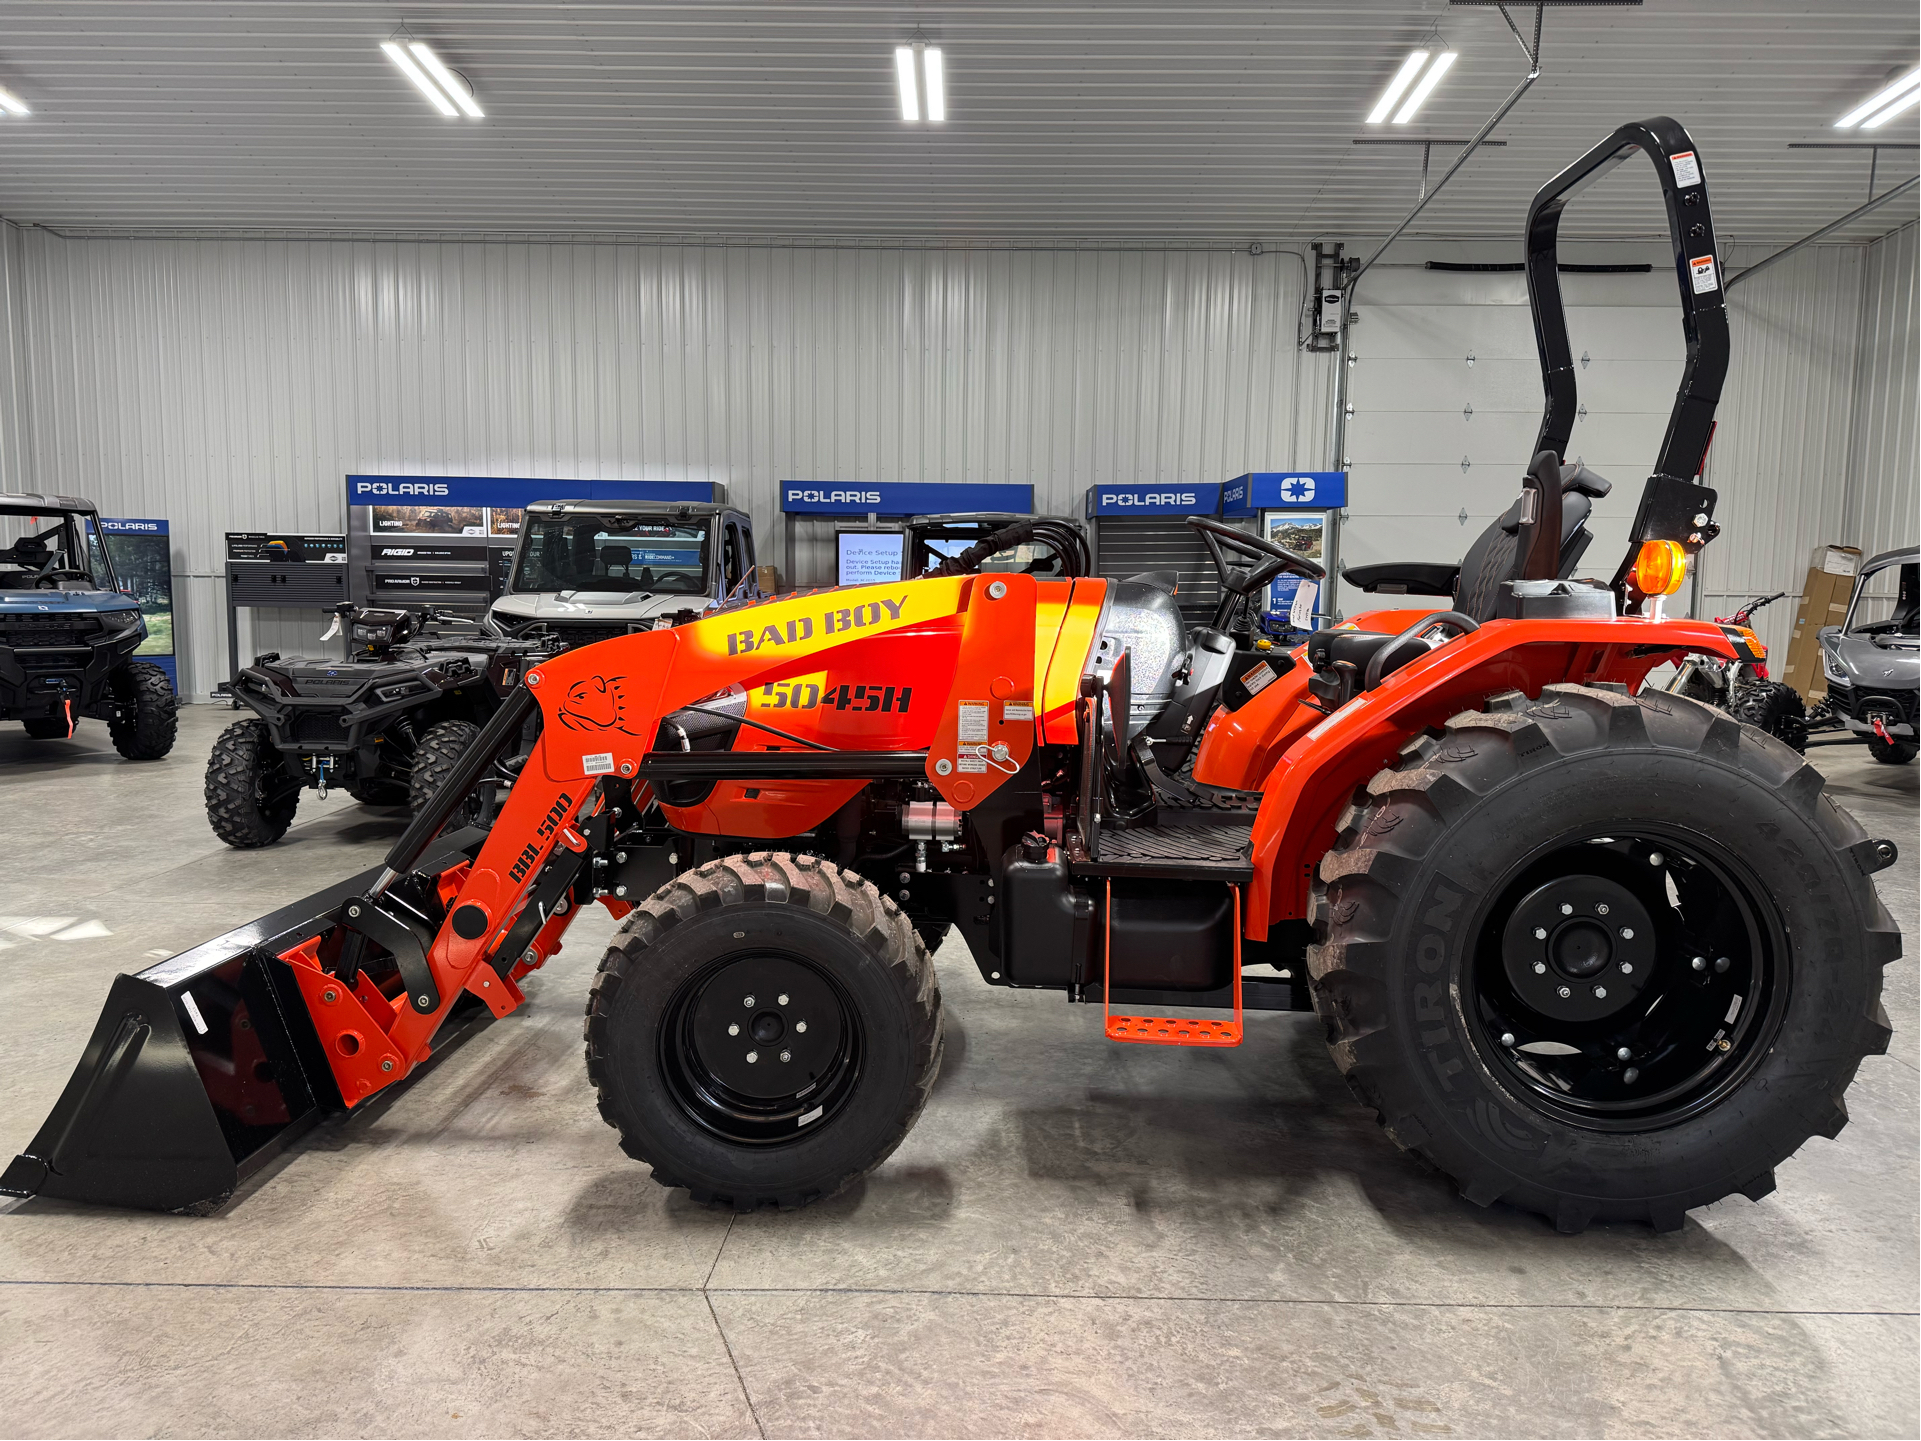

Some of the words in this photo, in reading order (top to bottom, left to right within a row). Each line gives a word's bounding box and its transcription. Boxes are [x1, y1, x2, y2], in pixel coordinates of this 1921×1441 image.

[357, 482, 449, 496] POLARIS
[788, 490, 881, 503] POLARIS
[1223, 486, 1244, 503] POLARIS
[1102, 493, 1197, 506] POLARIS
[381, 548, 414, 556] RIGID
[875, 549, 899, 557] Setup
[727, 617, 814, 656] BAD
[824, 595, 909, 635] BOY
[761, 682, 913, 713] 5045H
[508, 843, 544, 884] BBL
[536, 792, 573, 841] 500
[1414, 883, 1465, 1093] TIRON
